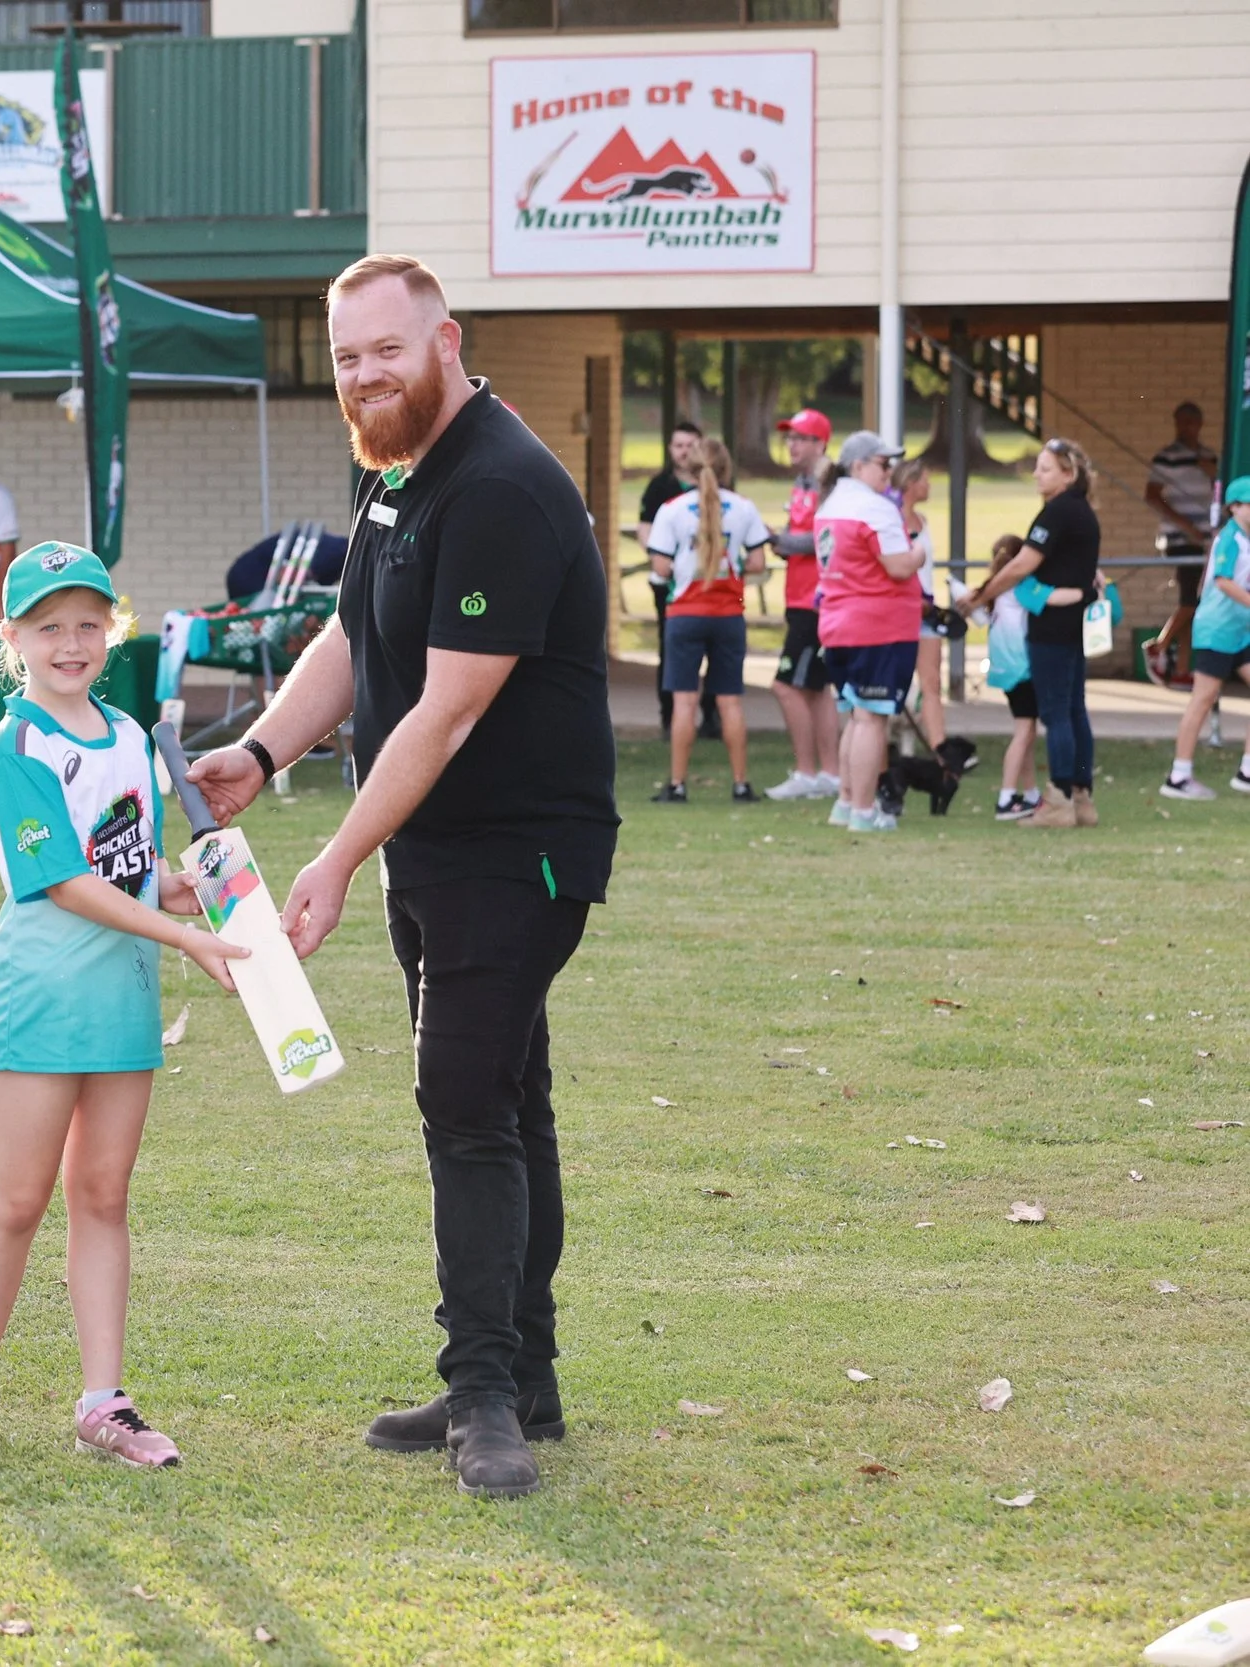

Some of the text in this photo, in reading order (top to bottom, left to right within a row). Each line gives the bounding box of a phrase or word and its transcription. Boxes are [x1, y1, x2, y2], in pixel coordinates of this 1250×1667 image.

[512, 80, 785, 131] Home of the
[516, 202, 783, 231] Murwillumbah
[646, 229, 780, 248] Panthers
[16, 825, 51, 852] cricket
[92, 824, 138, 862] CRICKET
[279, 1034, 331, 1074] cricket
